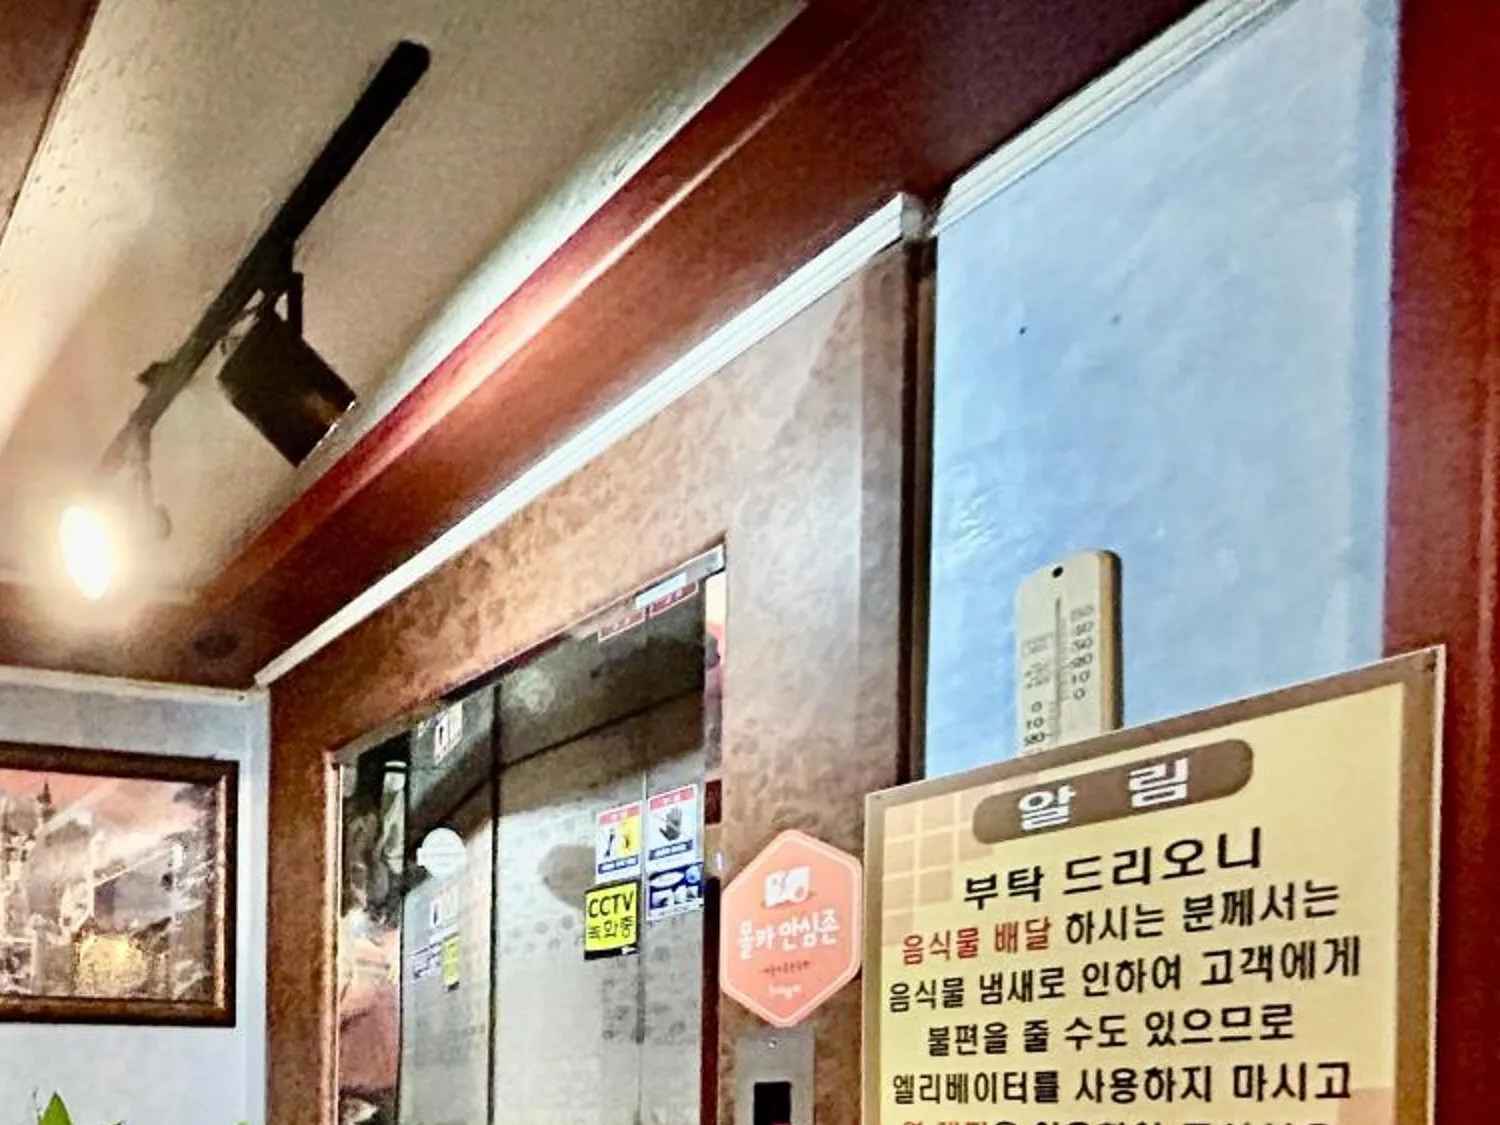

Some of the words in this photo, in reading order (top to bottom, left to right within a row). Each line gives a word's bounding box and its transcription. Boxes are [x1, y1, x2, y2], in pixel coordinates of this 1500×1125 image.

[964, 866, 1044, 910] 부탁
[1063, 827, 1261, 895] 드리오니
[588, 889, 634, 918] CCTV
[902, 927, 980, 966] 음식물
[994, 916, 1052, 954] 배달
[1066, 903, 1164, 945] 하시는
[1183, 880, 1339, 933] 분께서는
[889, 976, 964, 1013] 음식물
[979, 966, 1066, 1005] 냄새로
[1082, 954, 1181, 998] 인하여
[1201, 936, 1359, 985] 고객에게
[928, 1021, 1008, 1057] 불편을
[1023, 1019, 1049, 1053] 줄
[1064, 1015, 1128, 1050] 수도
[1145, 1004, 1294, 1047] 있으므로
[893, 1070, 1060, 1105] 엘리베이터를
[1075, 1066, 1211, 1104] 사용하지
[1233, 1062, 1351, 1102] 마시고
